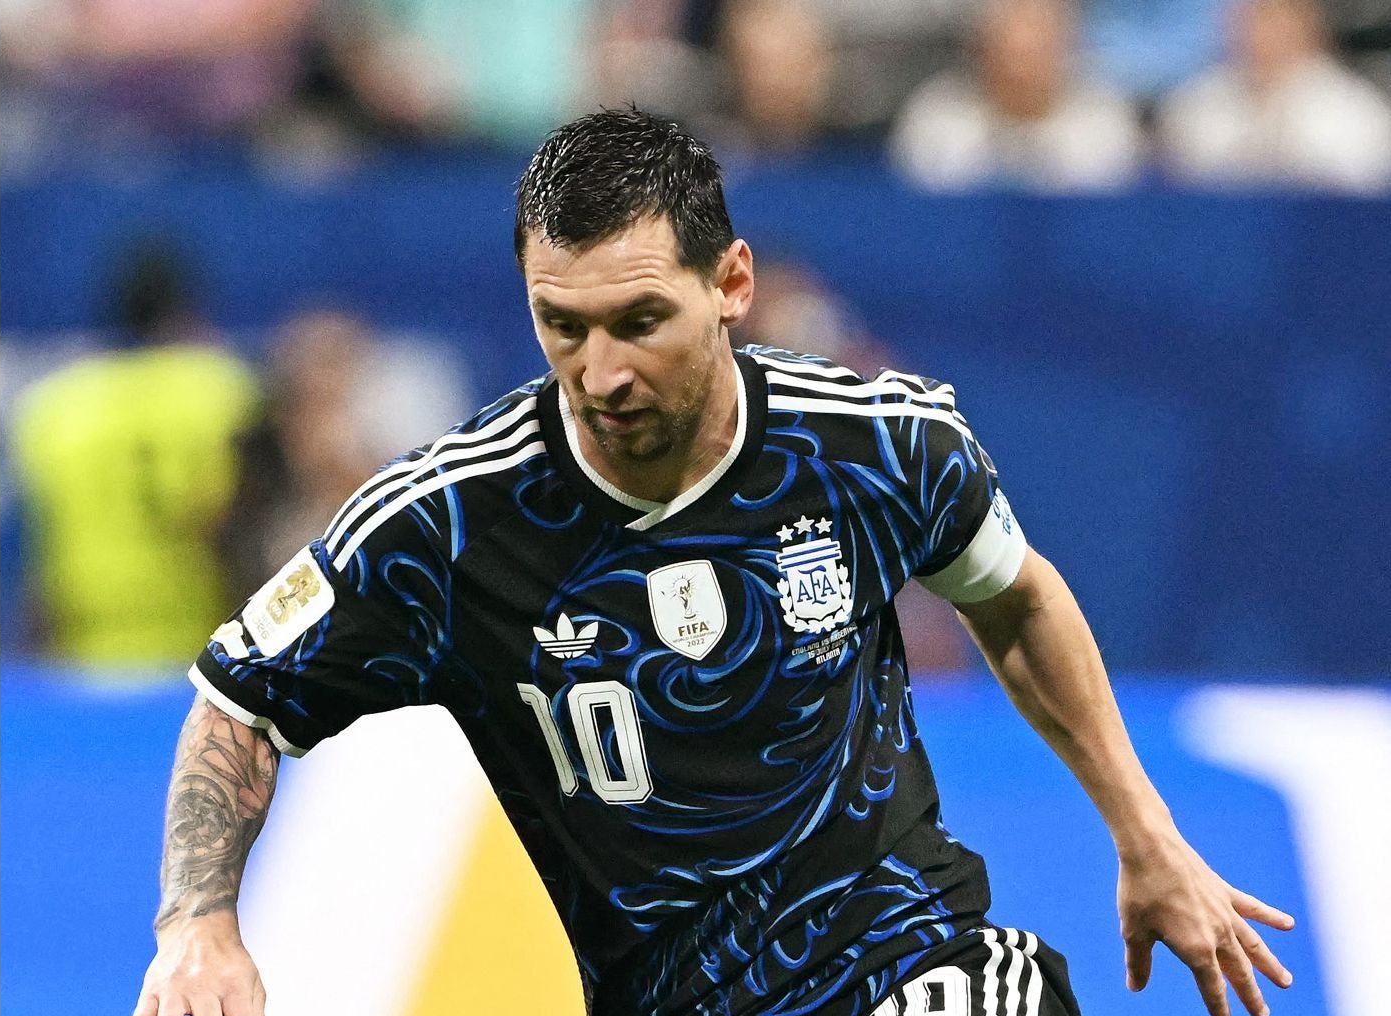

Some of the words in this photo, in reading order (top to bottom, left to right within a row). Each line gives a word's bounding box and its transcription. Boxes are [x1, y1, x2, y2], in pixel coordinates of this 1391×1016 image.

[796, 564, 837, 605] AFA
[678, 621, 710, 637] FIFA
[687, 638, 706, 648] 2022
[516, 680, 654, 805] 10
